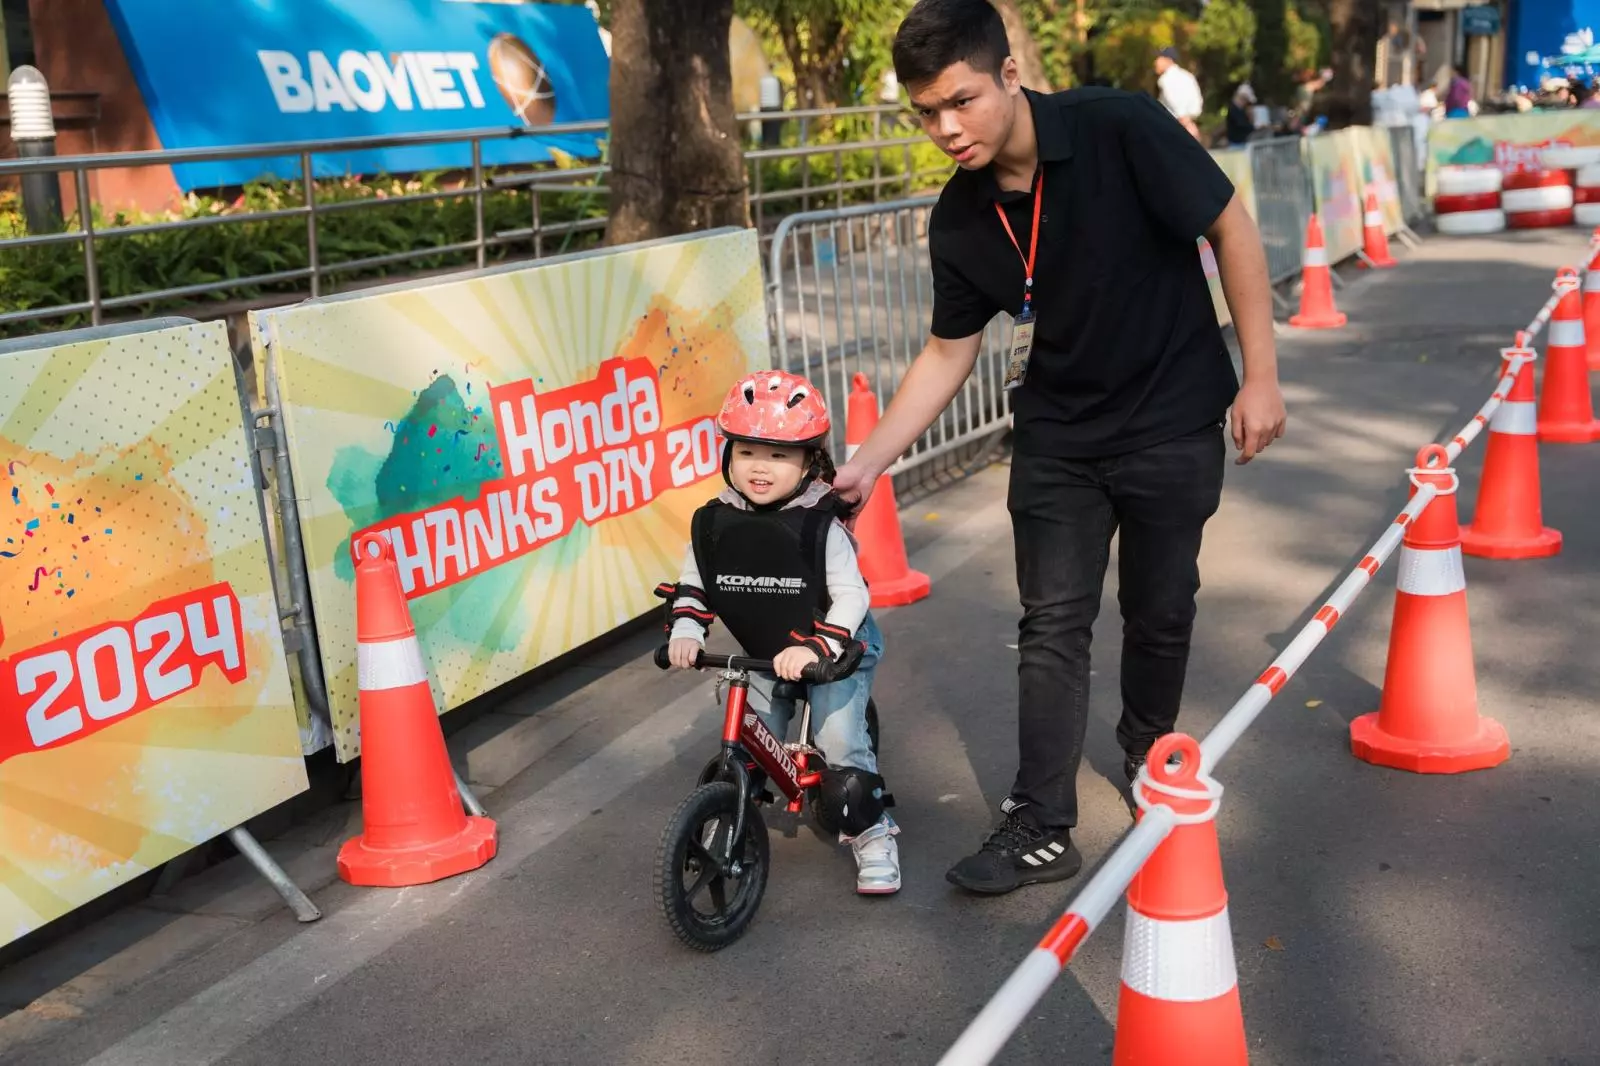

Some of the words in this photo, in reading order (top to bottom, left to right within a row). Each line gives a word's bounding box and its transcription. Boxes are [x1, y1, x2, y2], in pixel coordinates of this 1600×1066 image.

[256, 50, 485, 113] BAOVIET
[499, 367, 660, 477] Honda
[574, 440, 655, 522] DAY
[719, 585, 745, 593] SAFETY
[753, 586, 800, 595] INNOVATION
[15, 595, 240, 747] 2024
[754, 721, 801, 788] HONDA
